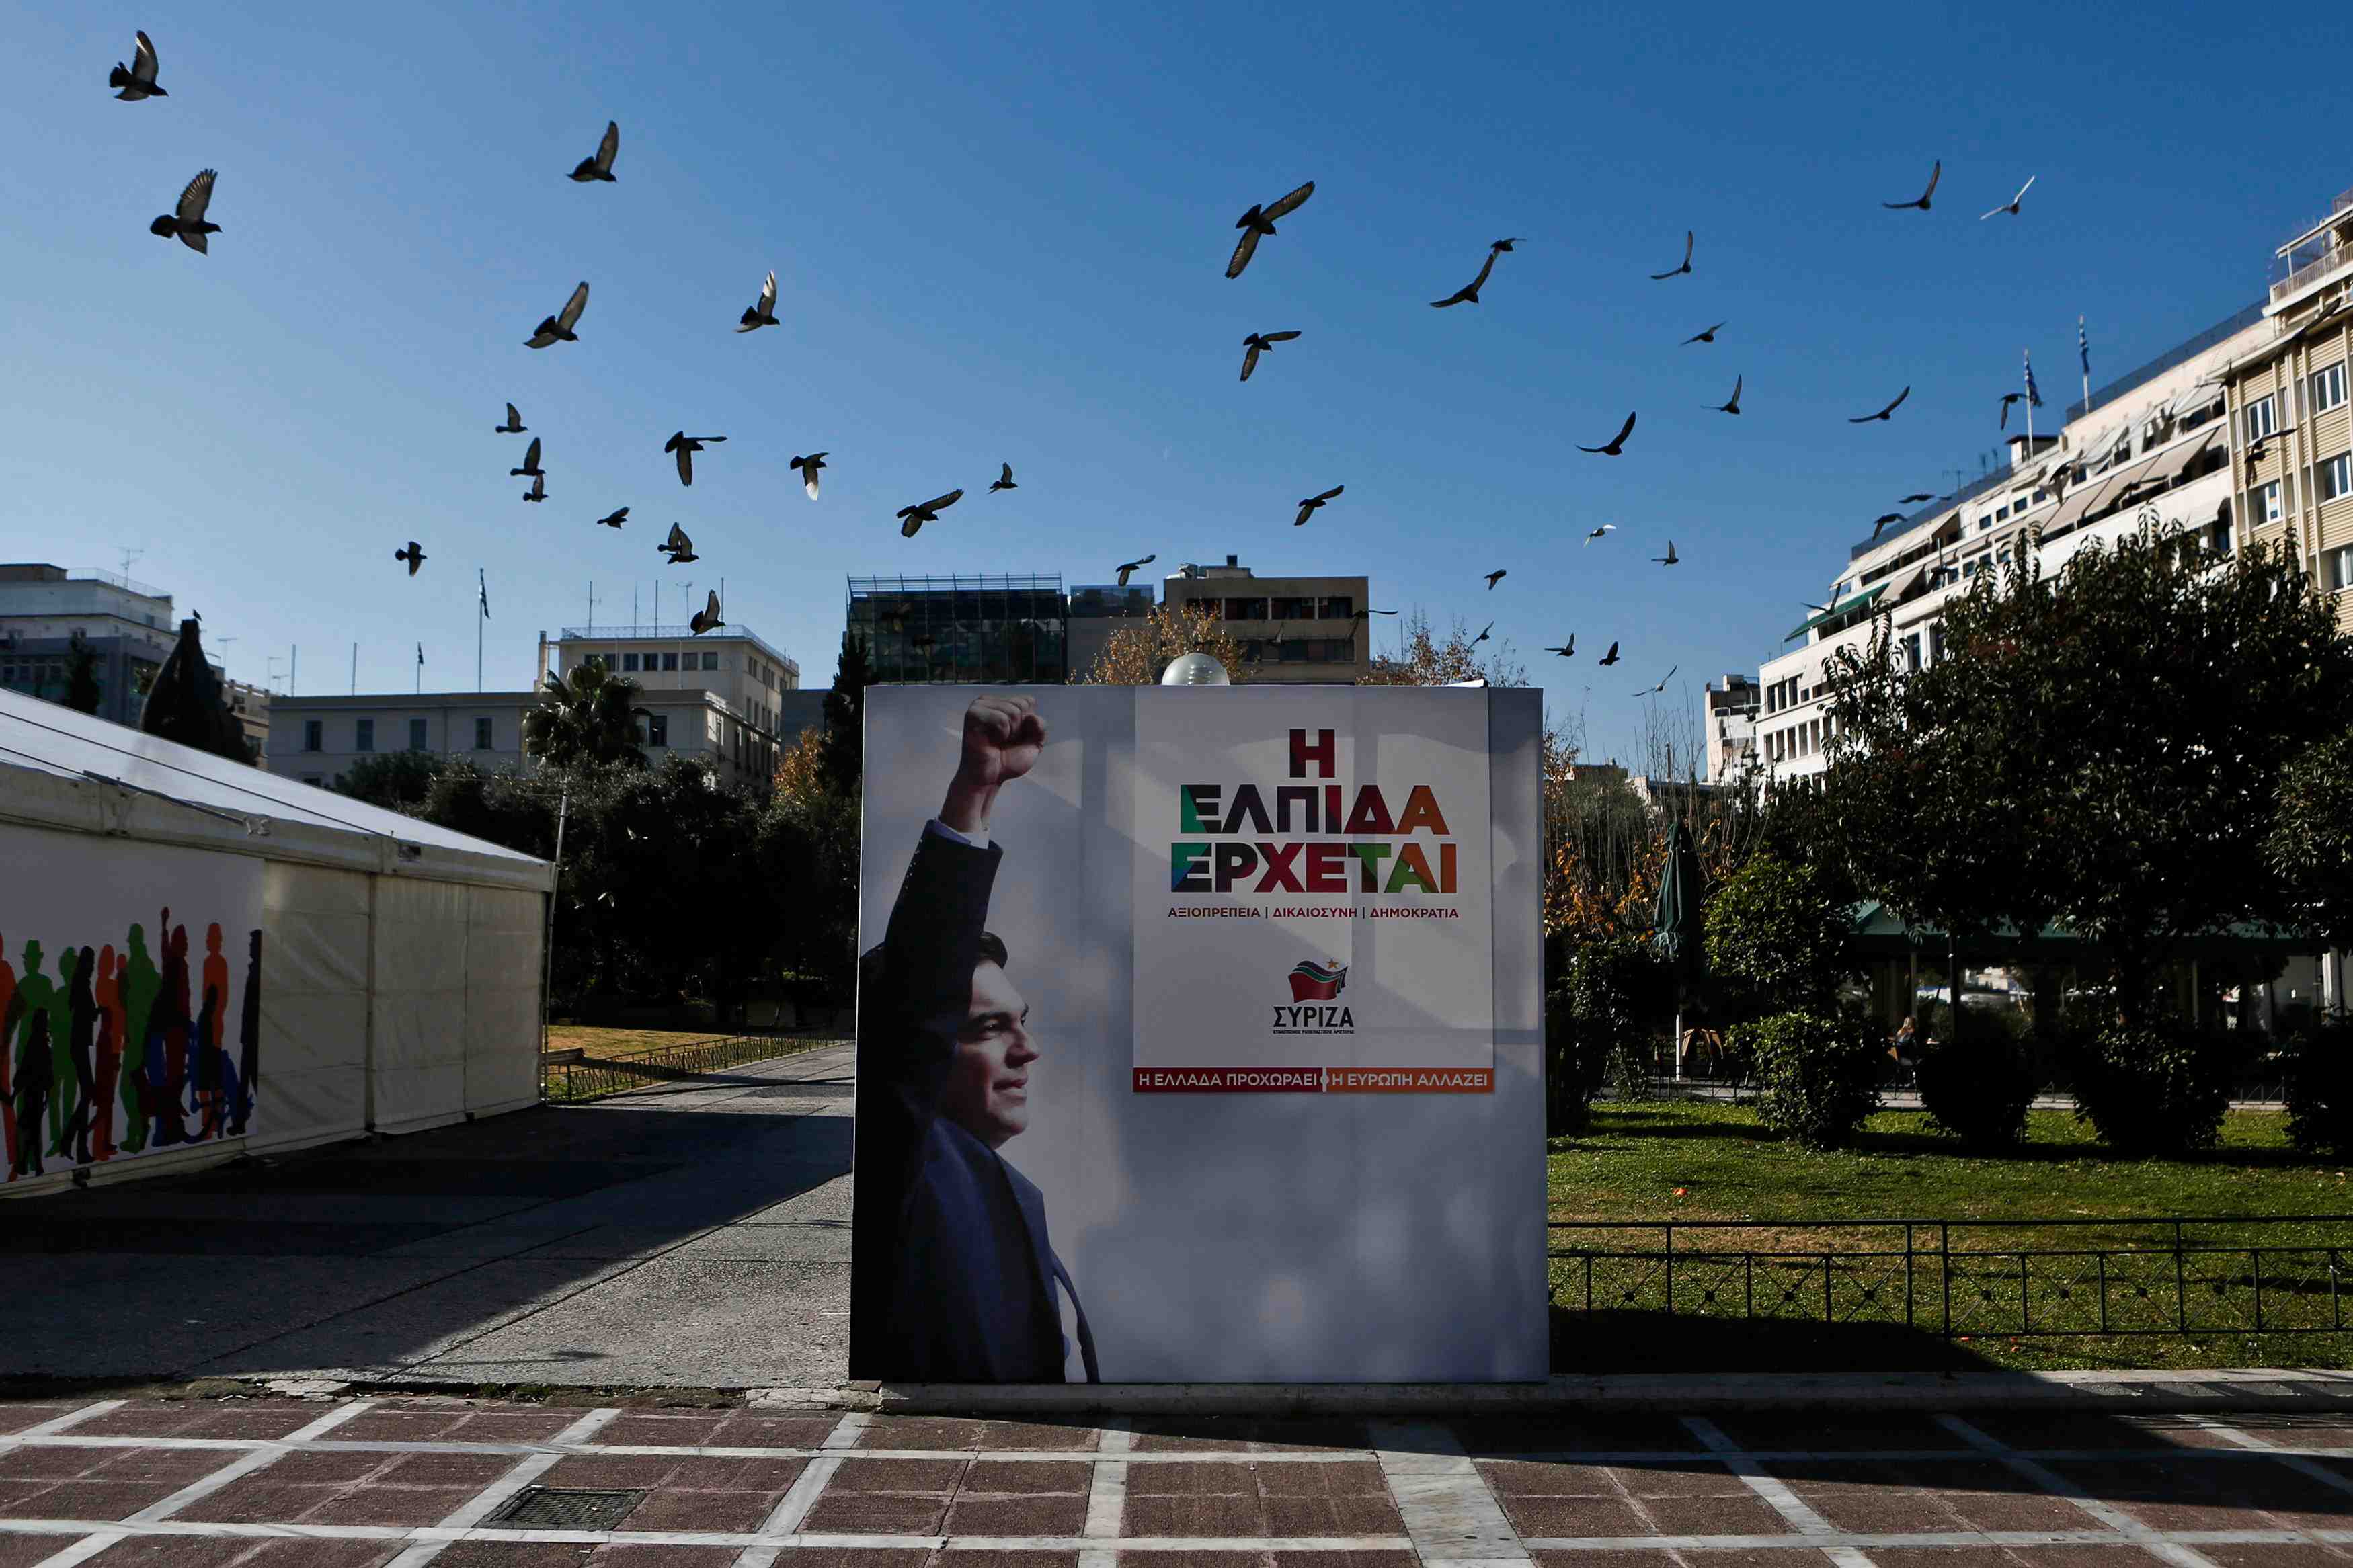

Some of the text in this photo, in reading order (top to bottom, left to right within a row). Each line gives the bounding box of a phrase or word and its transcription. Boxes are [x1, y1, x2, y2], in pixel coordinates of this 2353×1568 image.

[1289, 728, 1335, 778] Η
[1180, 784, 1450, 835] ΕΛΠΙΔΑ
[1171, 842, 1457, 893] ΕΡΧΕΤΑΙ
[1168, 907, 1459, 919] ΑΞΙΟΠΡΕΠΕΙΑ ΔΙΚΑΙΟΣΥΝΗ ΔΗΜΟΚΡΑΤΙΑ
[1273, 1006, 1354, 1028] ΣΥΡΙΖΑ
[1139, 1073, 1317, 1086] Η ΕΛΛΑΔΑ ΠΡΟΧΩΡΑΕΙ
[1332, 1073, 1488, 1086] Η ΕΥΡΩΠΗ ΑΛΛΑΖΕΙ
